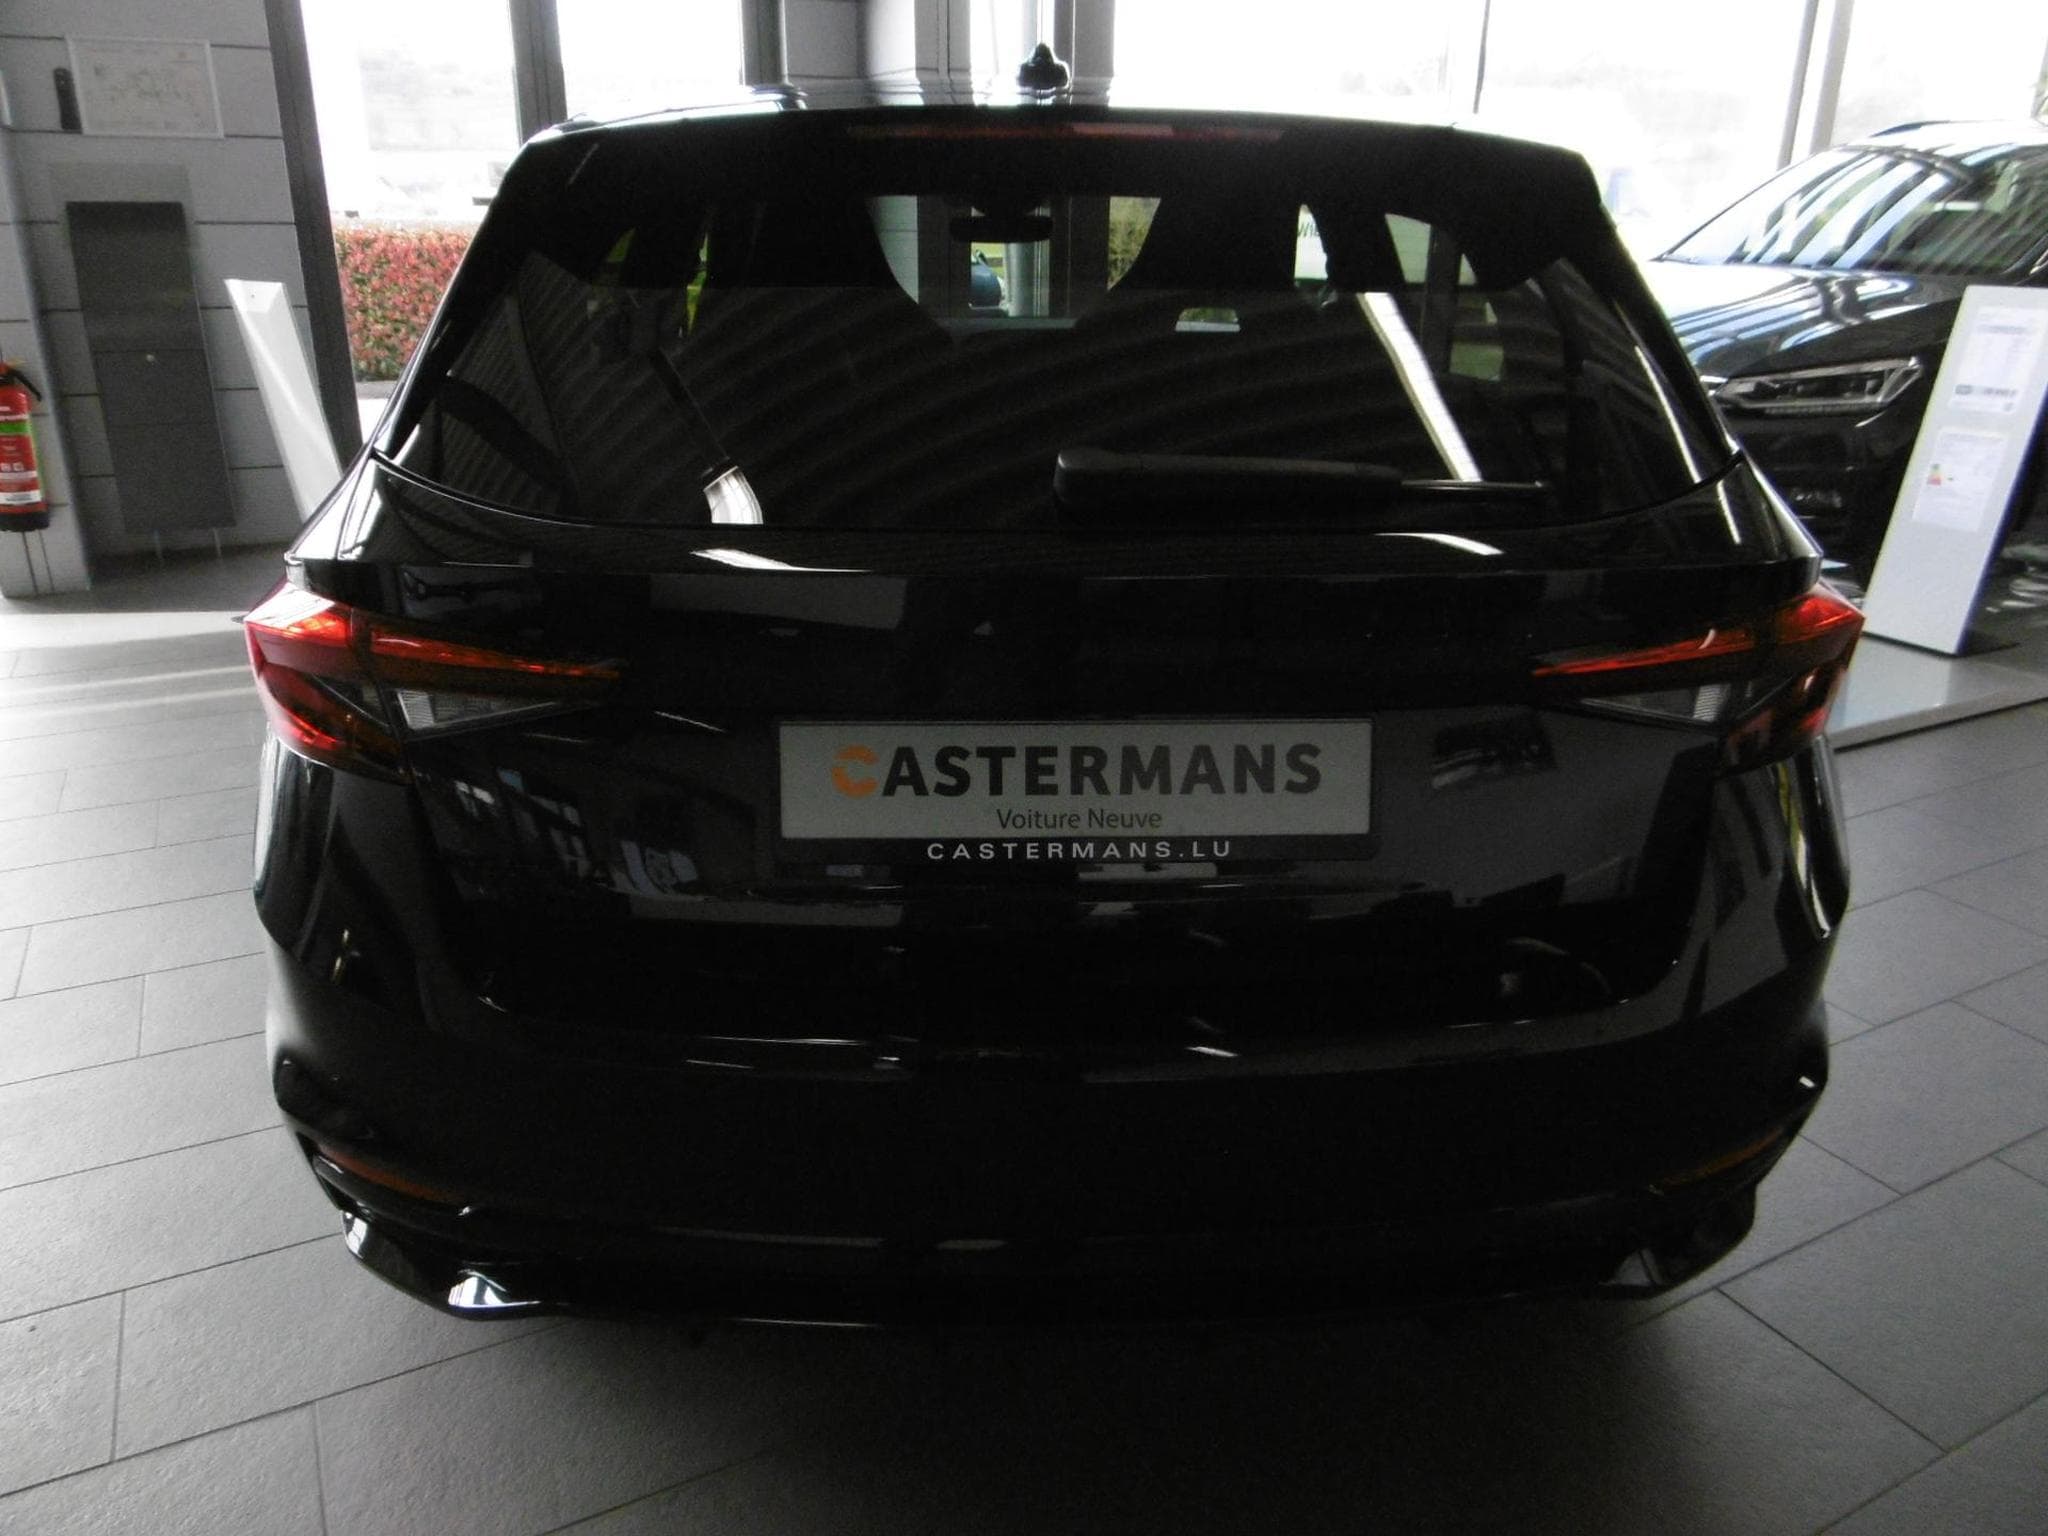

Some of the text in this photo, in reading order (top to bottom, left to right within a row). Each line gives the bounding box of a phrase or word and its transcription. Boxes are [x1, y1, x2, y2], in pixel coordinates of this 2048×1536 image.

[831, 743, 1321, 797] CASTERMANS
[996, 808, 1163, 829] Voiture Neuve
[927, 841, 1230, 860] CASTERMANS.LU
